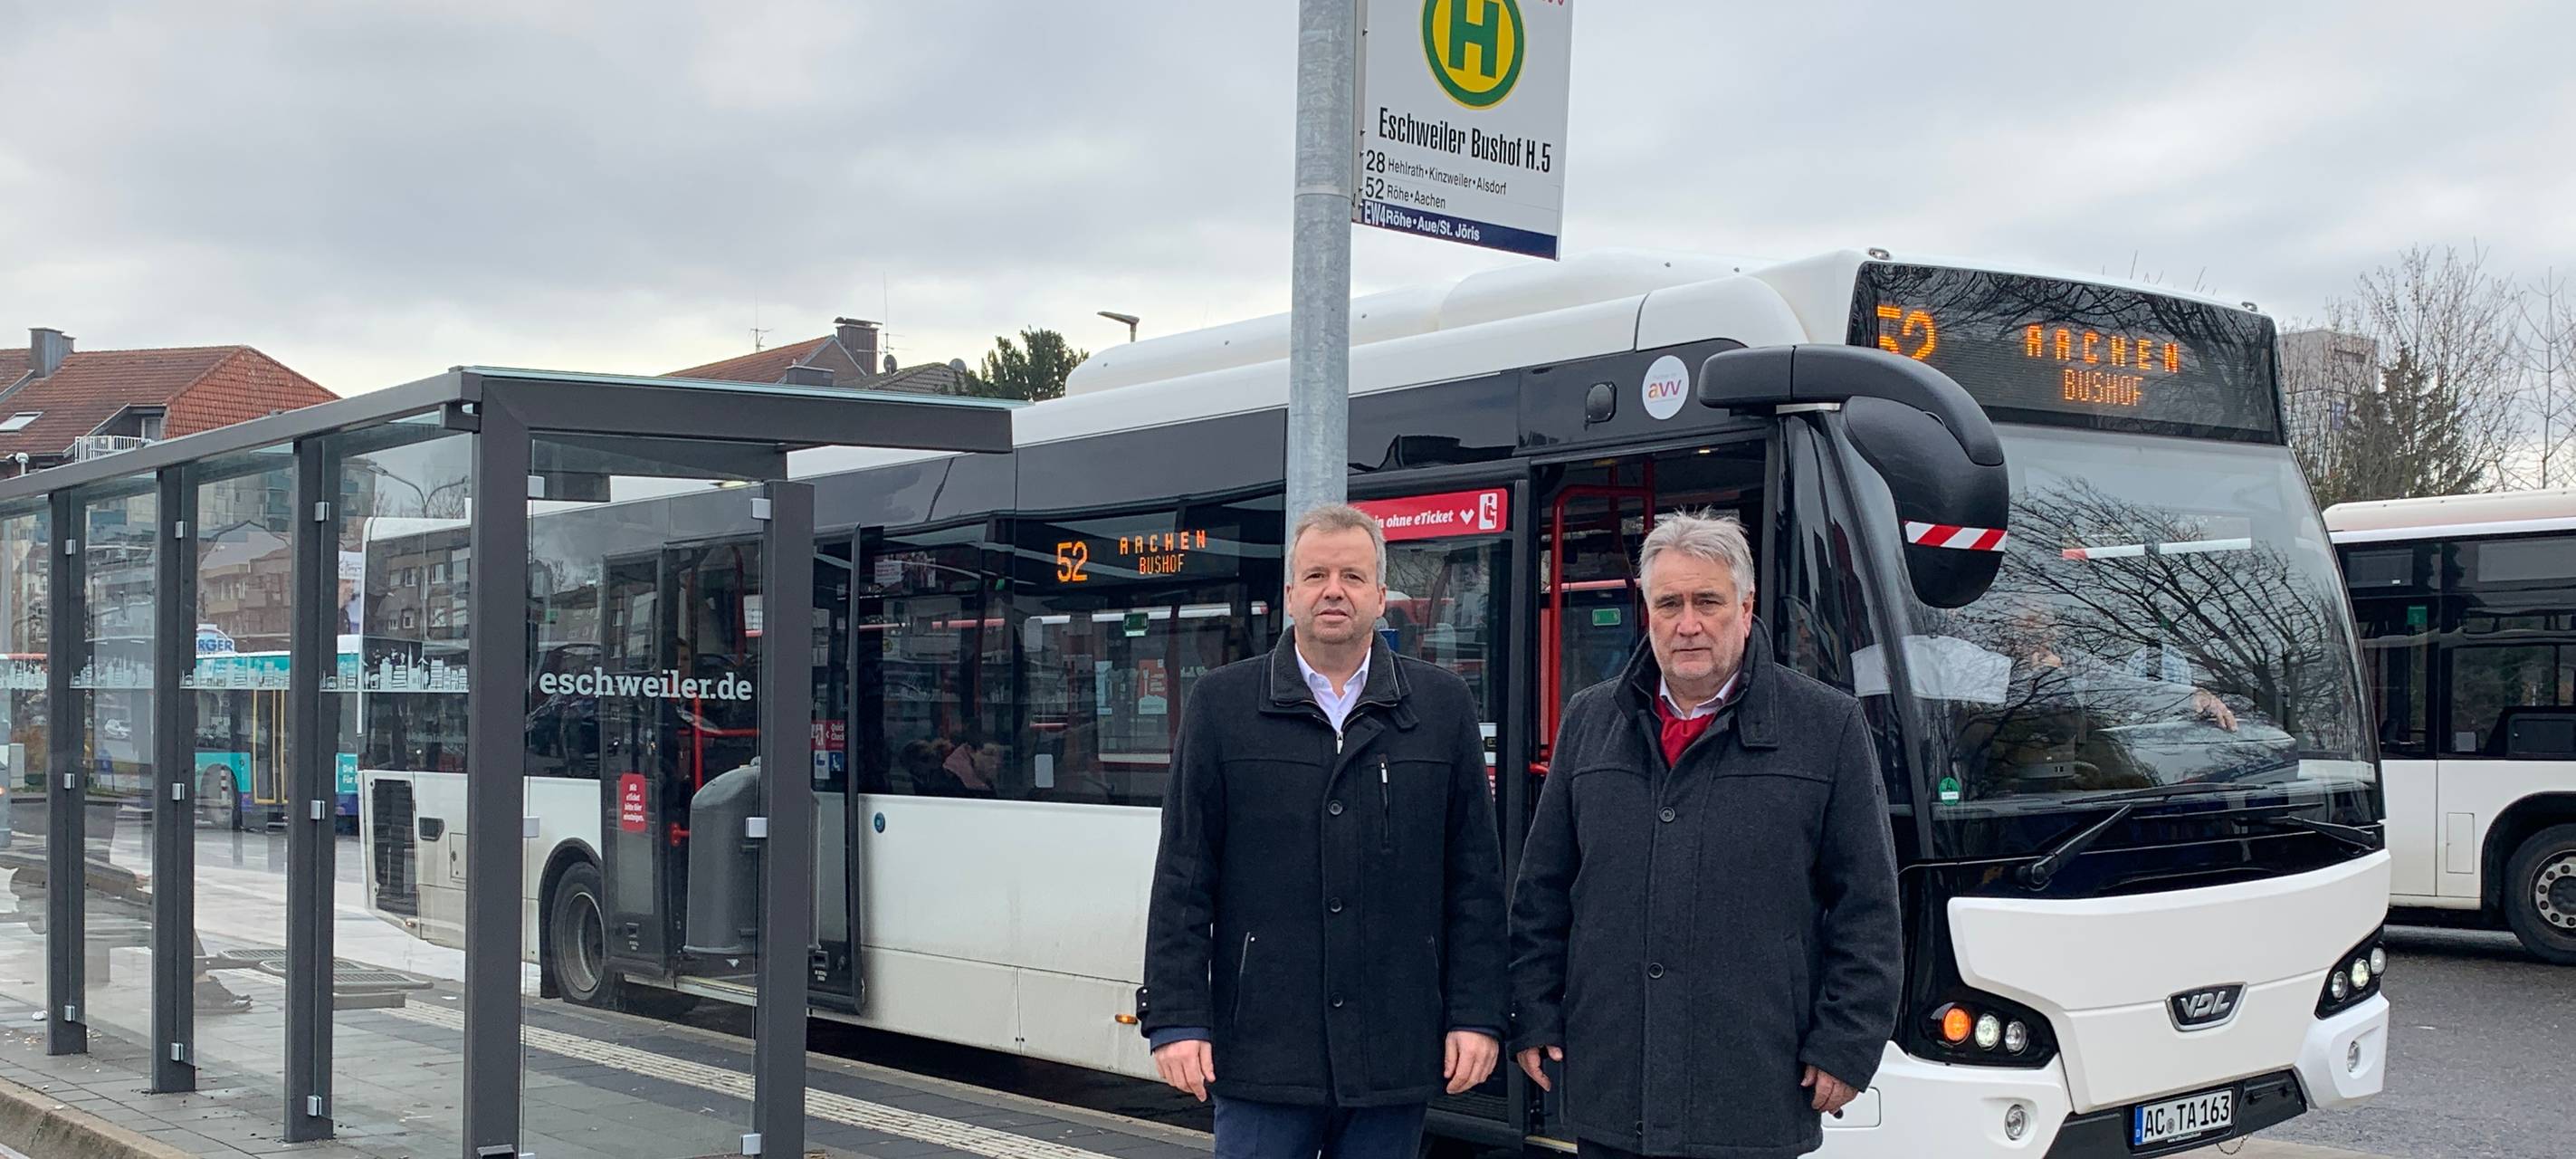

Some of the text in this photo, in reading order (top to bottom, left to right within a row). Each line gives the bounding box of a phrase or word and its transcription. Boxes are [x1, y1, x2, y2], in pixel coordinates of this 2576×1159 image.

[1449, 0, 1499, 78] H
[1379, 107, 1551, 173] Eschweiler Bushof H.5
[1366, 149, 1385, 174] 28
[1365, 177, 1384, 199] 52
[2027, 325, 2179, 373] AACHEN
[1648, 379, 1682, 398] avv
[2065, 369, 2143, 407] BUSHOF
[1387, 513, 1411, 528] ohne
[1414, 510, 1454, 526] eTicket
[1057, 530, 1207, 582] 52 AACHEN
[1139, 553, 1185, 575] BUSHOF
[539, 666, 753, 700] eschweiler.de
[2180, 991, 2230, 1018] VDL
[2144, 1107, 2165, 1138] AC
